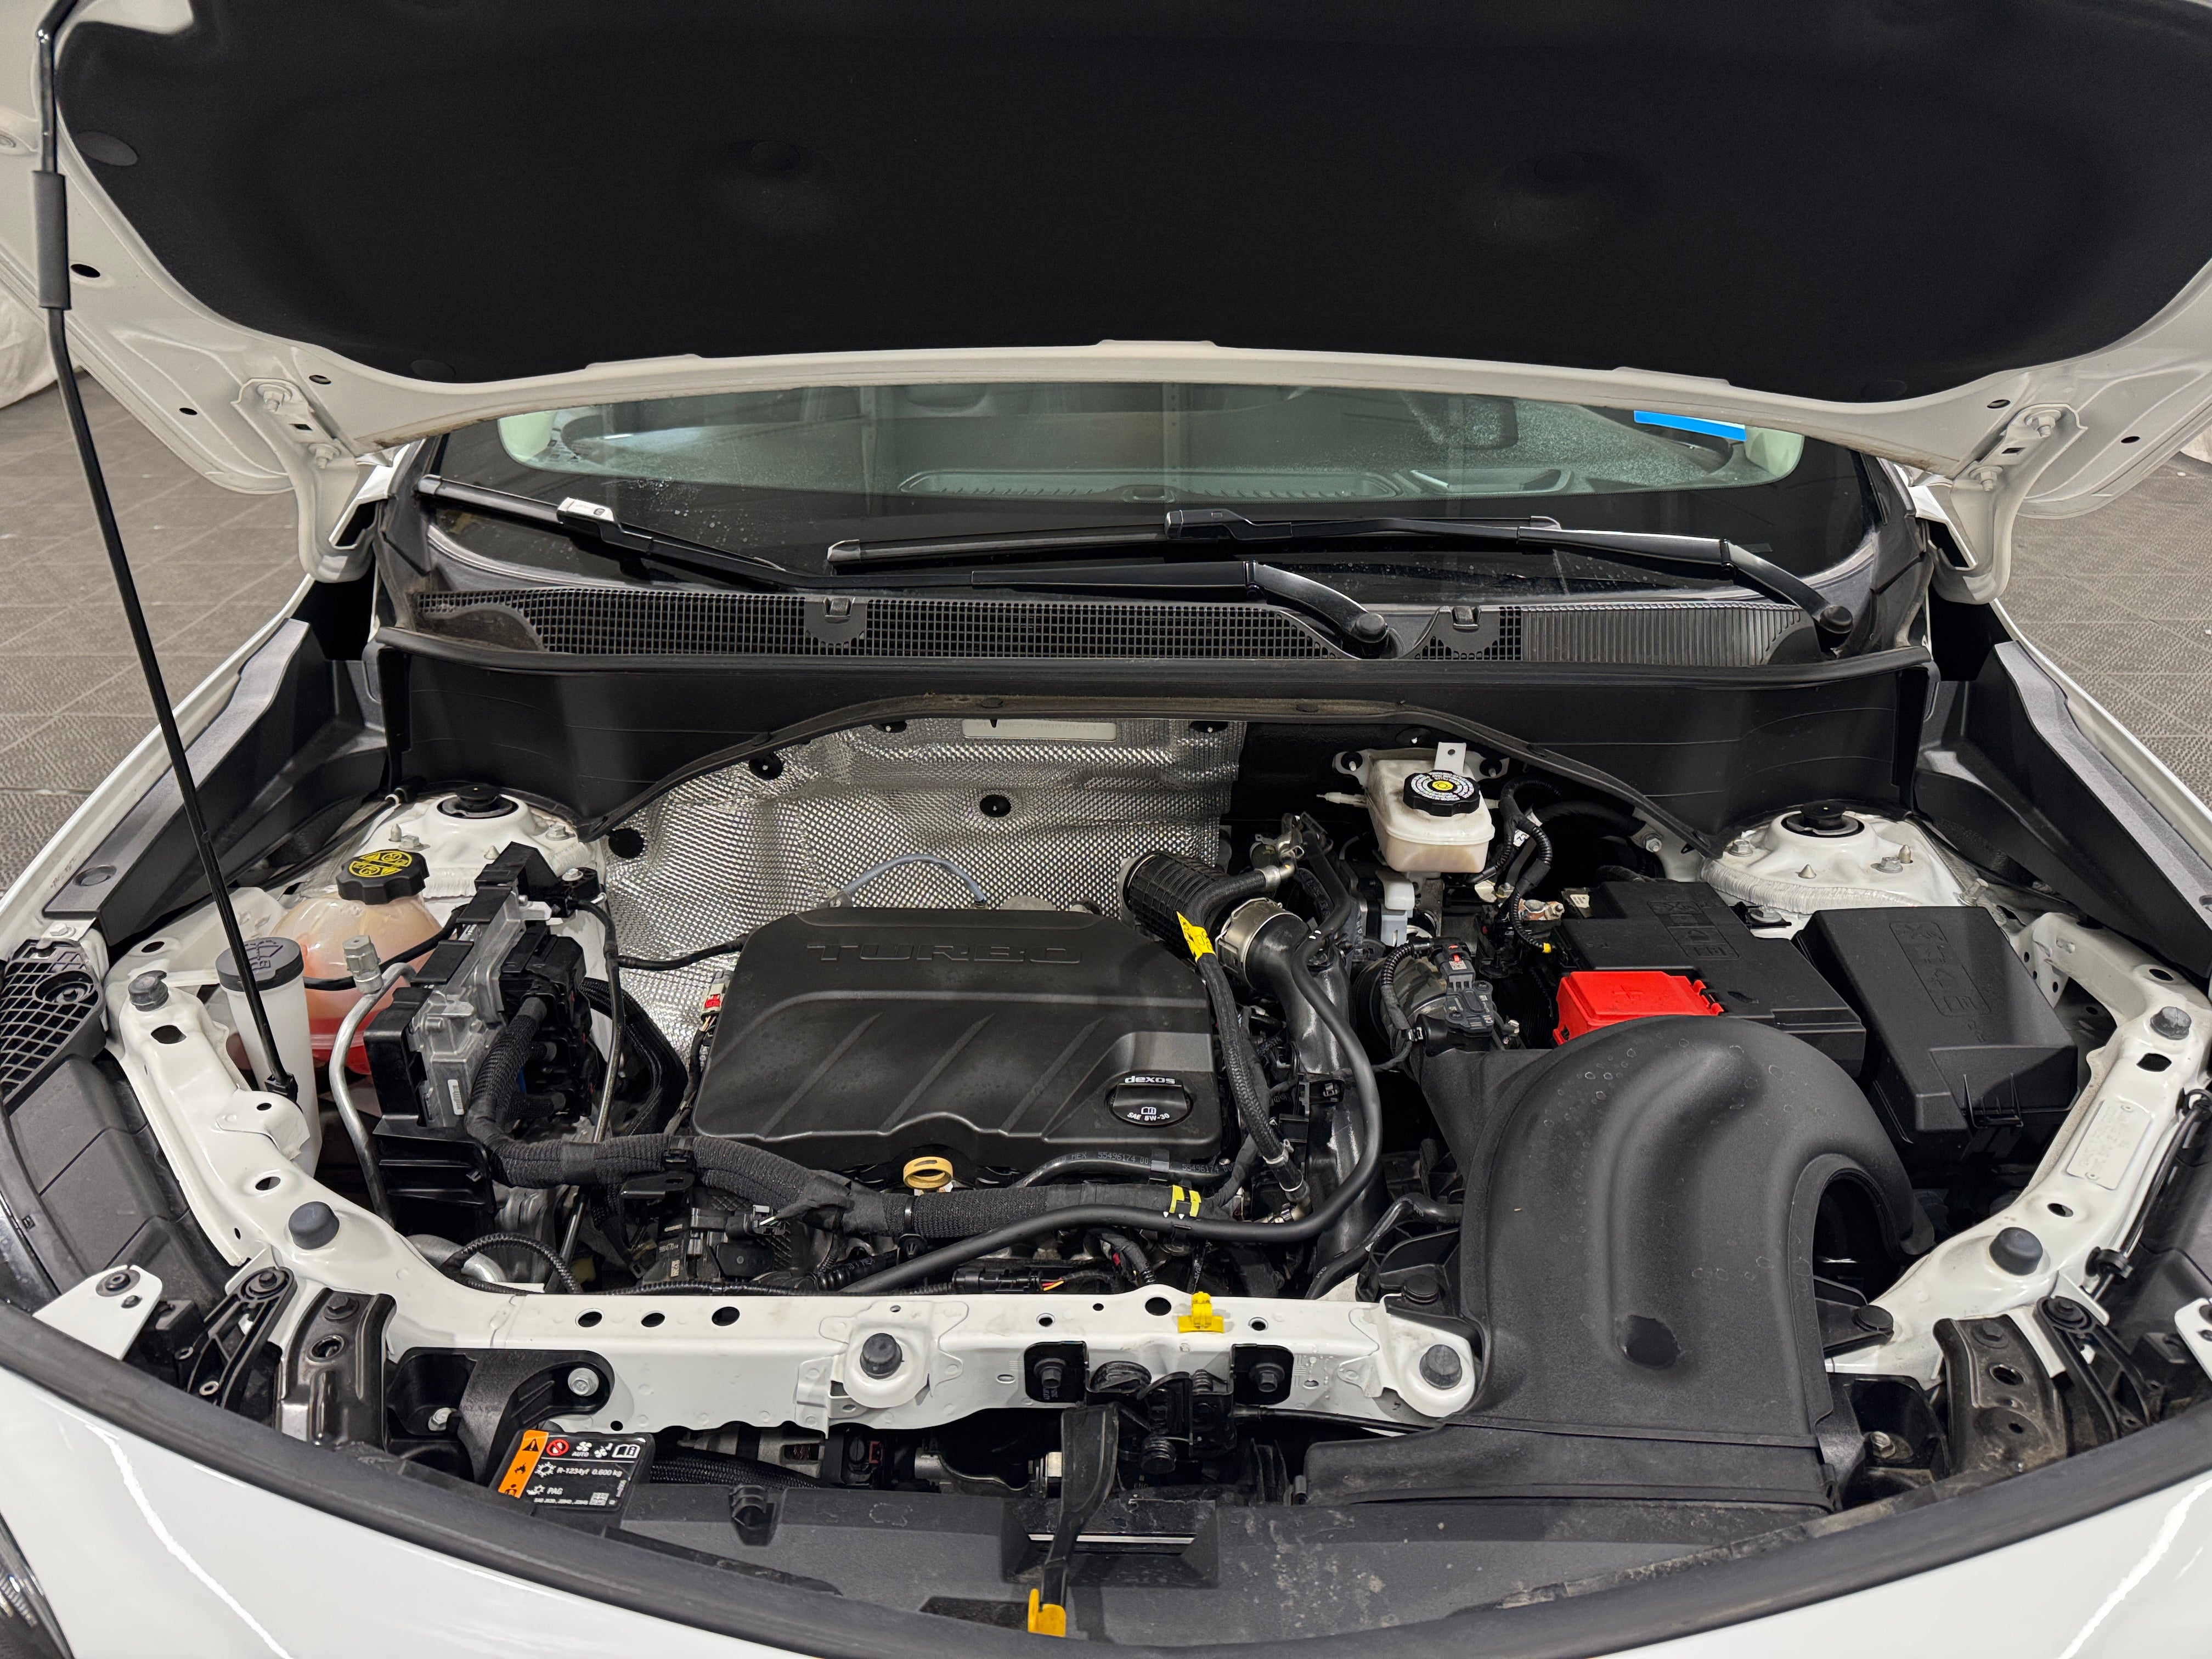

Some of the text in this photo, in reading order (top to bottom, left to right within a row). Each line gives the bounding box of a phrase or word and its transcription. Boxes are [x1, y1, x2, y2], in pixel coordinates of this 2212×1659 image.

[806, 943, 1082, 964] TURBO
[1125, 1076, 1175, 1084] dexos
[1127, 1112, 1170, 1121] SAE 5W-30
[1098, 1152, 1136, 1163] 55496174
[1182, 1164, 1219, 1172] 55496174
[556, 1467, 590, 1476] R-1234yf
[546, 1487, 563, 1495] PAG
